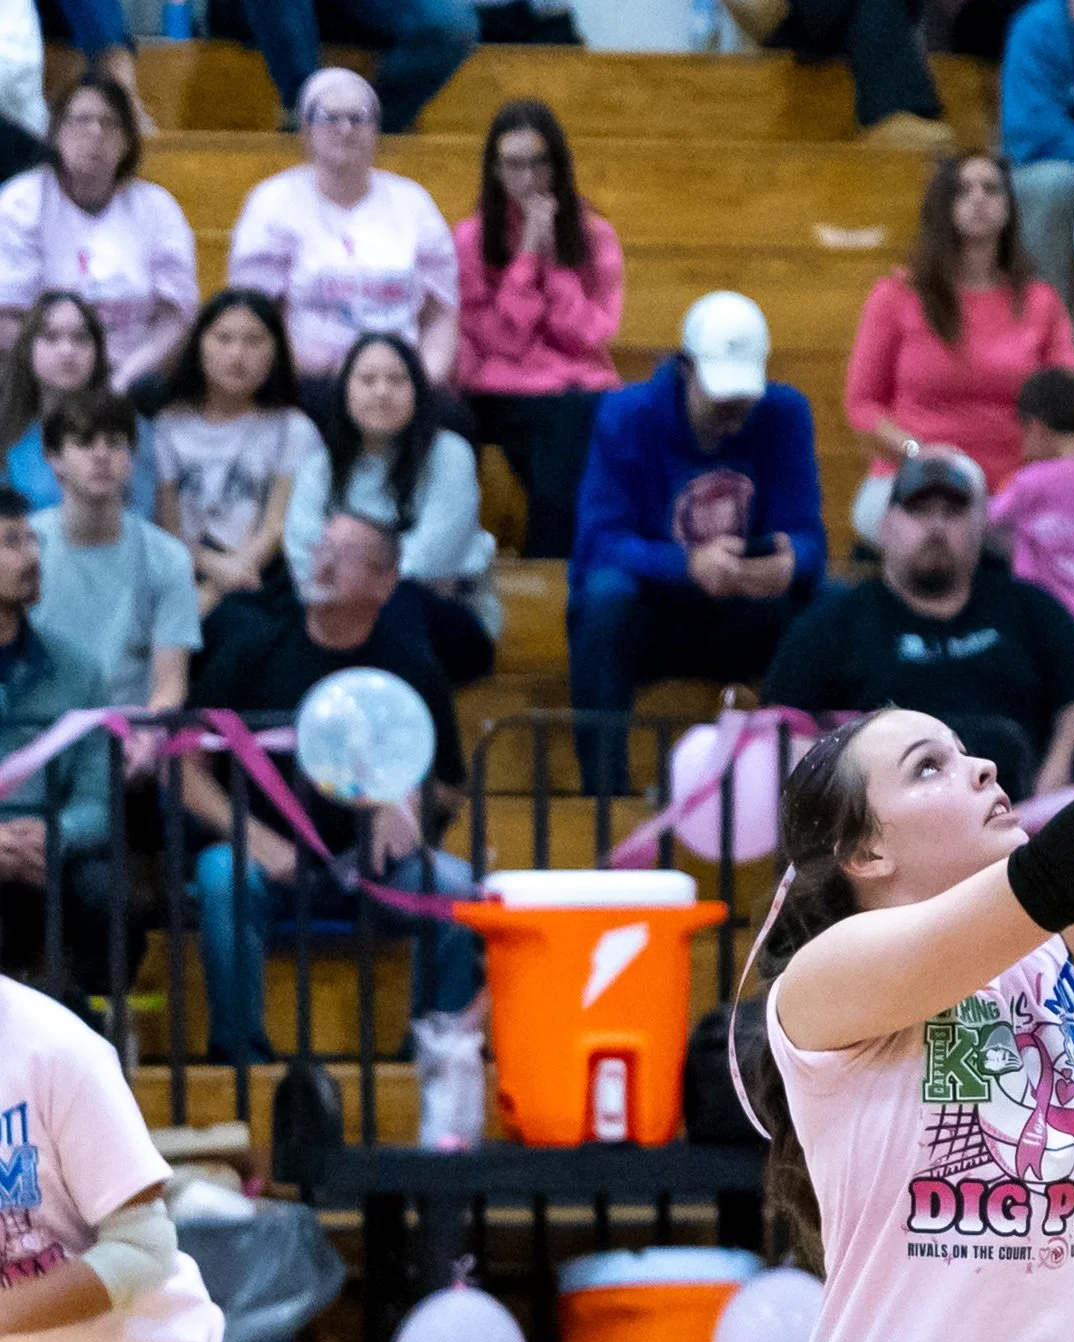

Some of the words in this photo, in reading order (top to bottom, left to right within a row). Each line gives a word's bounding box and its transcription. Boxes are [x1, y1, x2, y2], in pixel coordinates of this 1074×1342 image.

[932, 1030, 947, 1094] CAPTAINS
[0, 1100, 29, 1146] TT
[907, 1176, 1033, 1237] DIG
[907, 1242, 949, 1258] RIVALS
[952, 1244, 969, 1259] ON
[972, 1245, 995, 1260] THE
